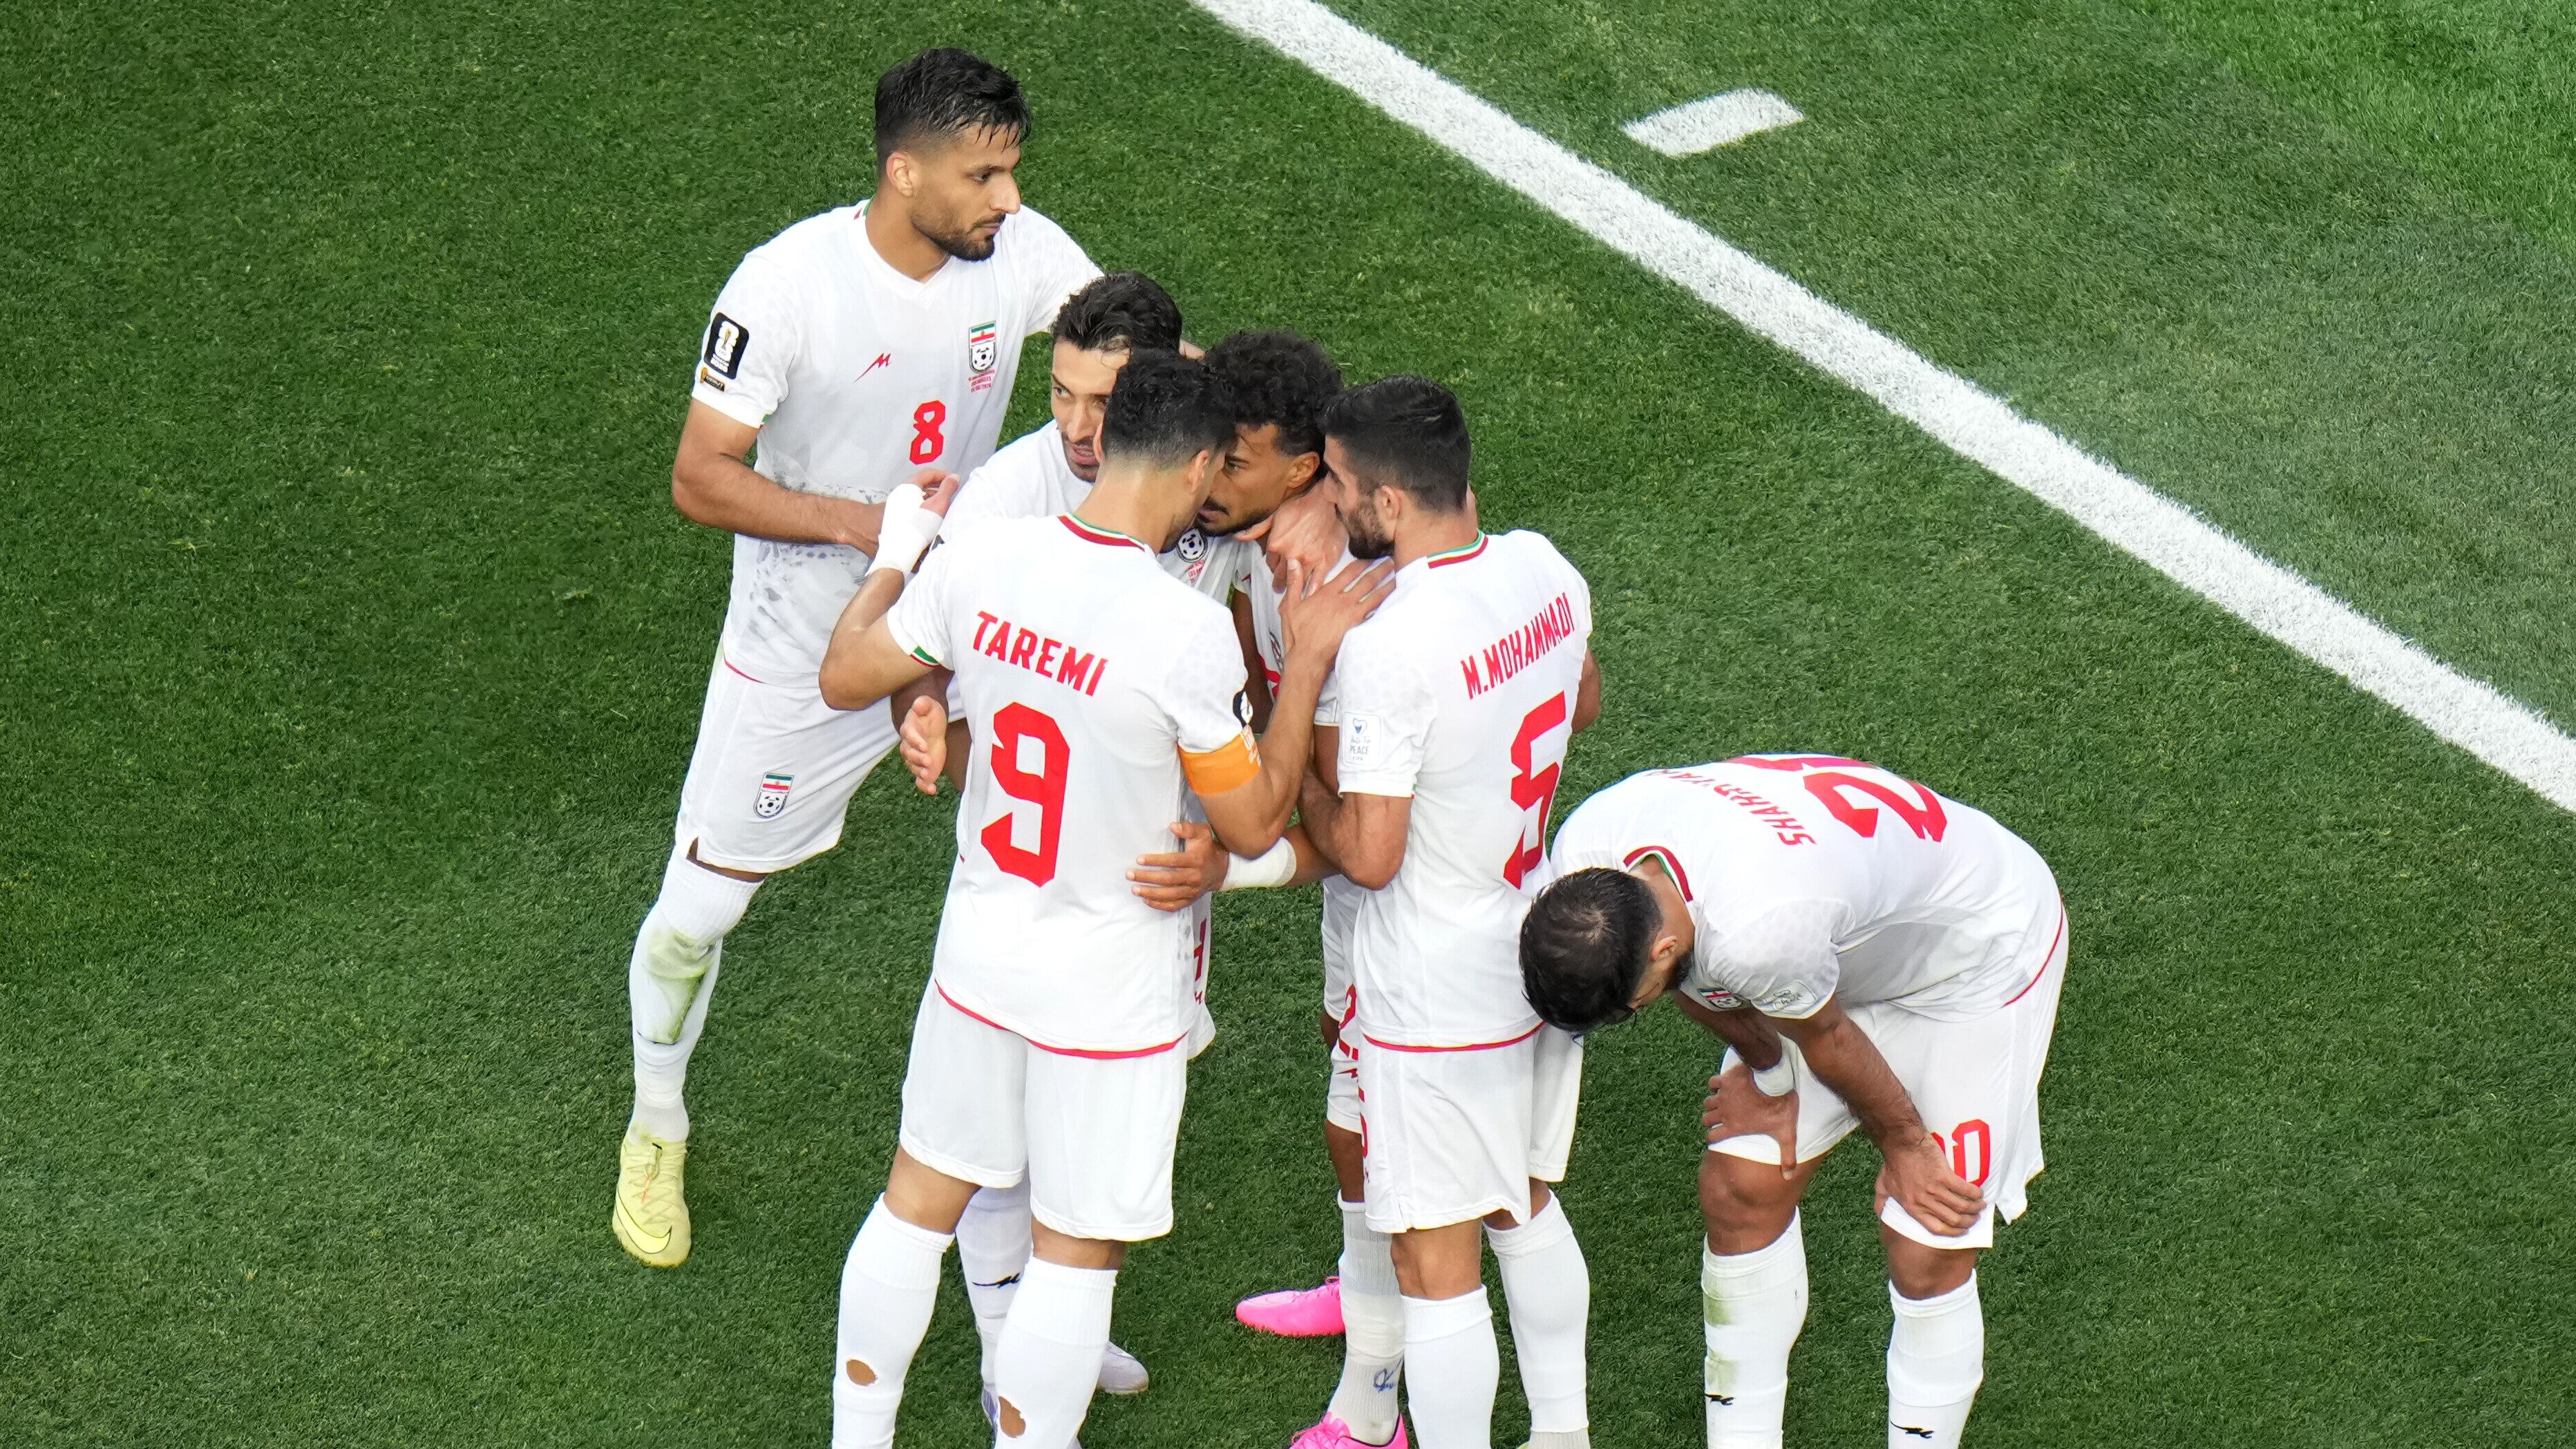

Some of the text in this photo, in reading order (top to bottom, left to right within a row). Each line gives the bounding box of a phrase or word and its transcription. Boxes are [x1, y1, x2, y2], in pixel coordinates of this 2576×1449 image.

[909, 400, 946, 465] 8
[973, 610, 1109, 697] TAREMI
[1460, 591, 1575, 700] M.MOHAMMADI
[981, 701, 1070, 888] 9
[1503, 689, 1566, 890] 5
[1931, 1119, 1991, 1188] 0
